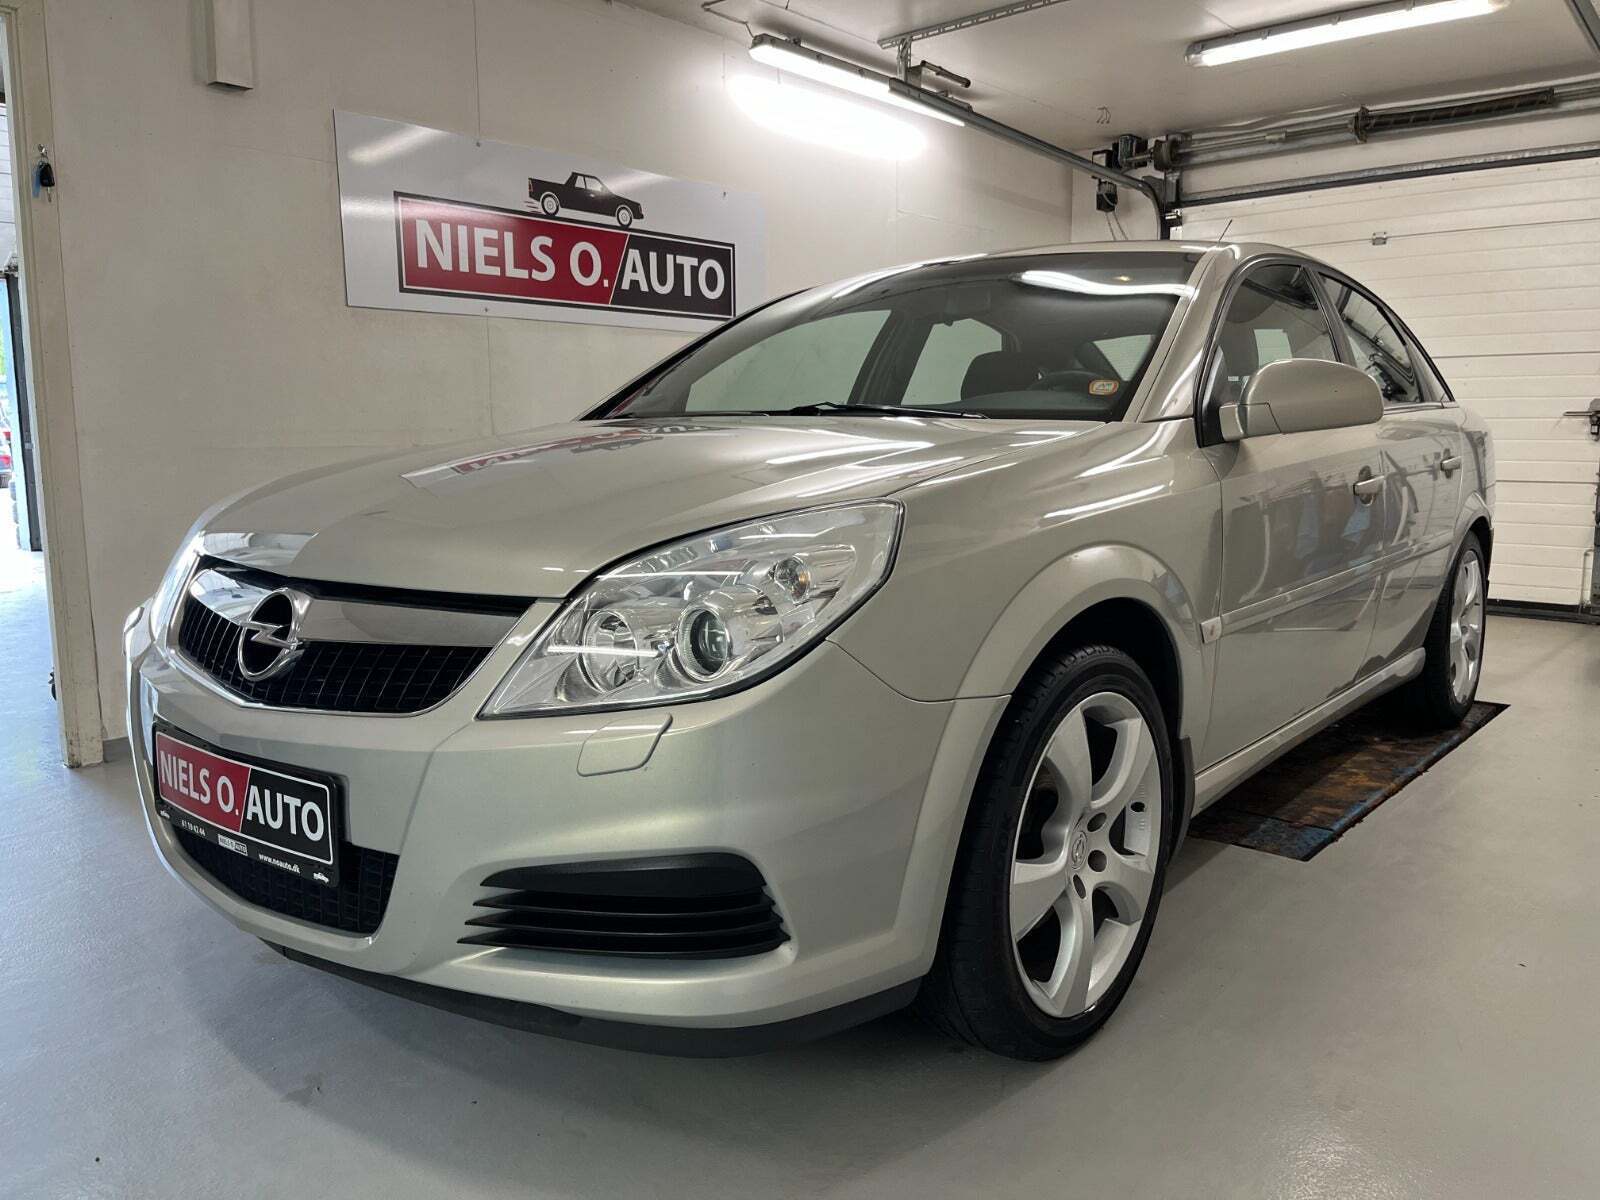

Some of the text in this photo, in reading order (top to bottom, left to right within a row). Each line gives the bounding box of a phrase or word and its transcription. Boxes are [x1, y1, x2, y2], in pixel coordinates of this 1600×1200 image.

[415, 218, 725, 300] NIELS O. AUTO
[159, 750, 325, 842] NIELS O. AUTO
